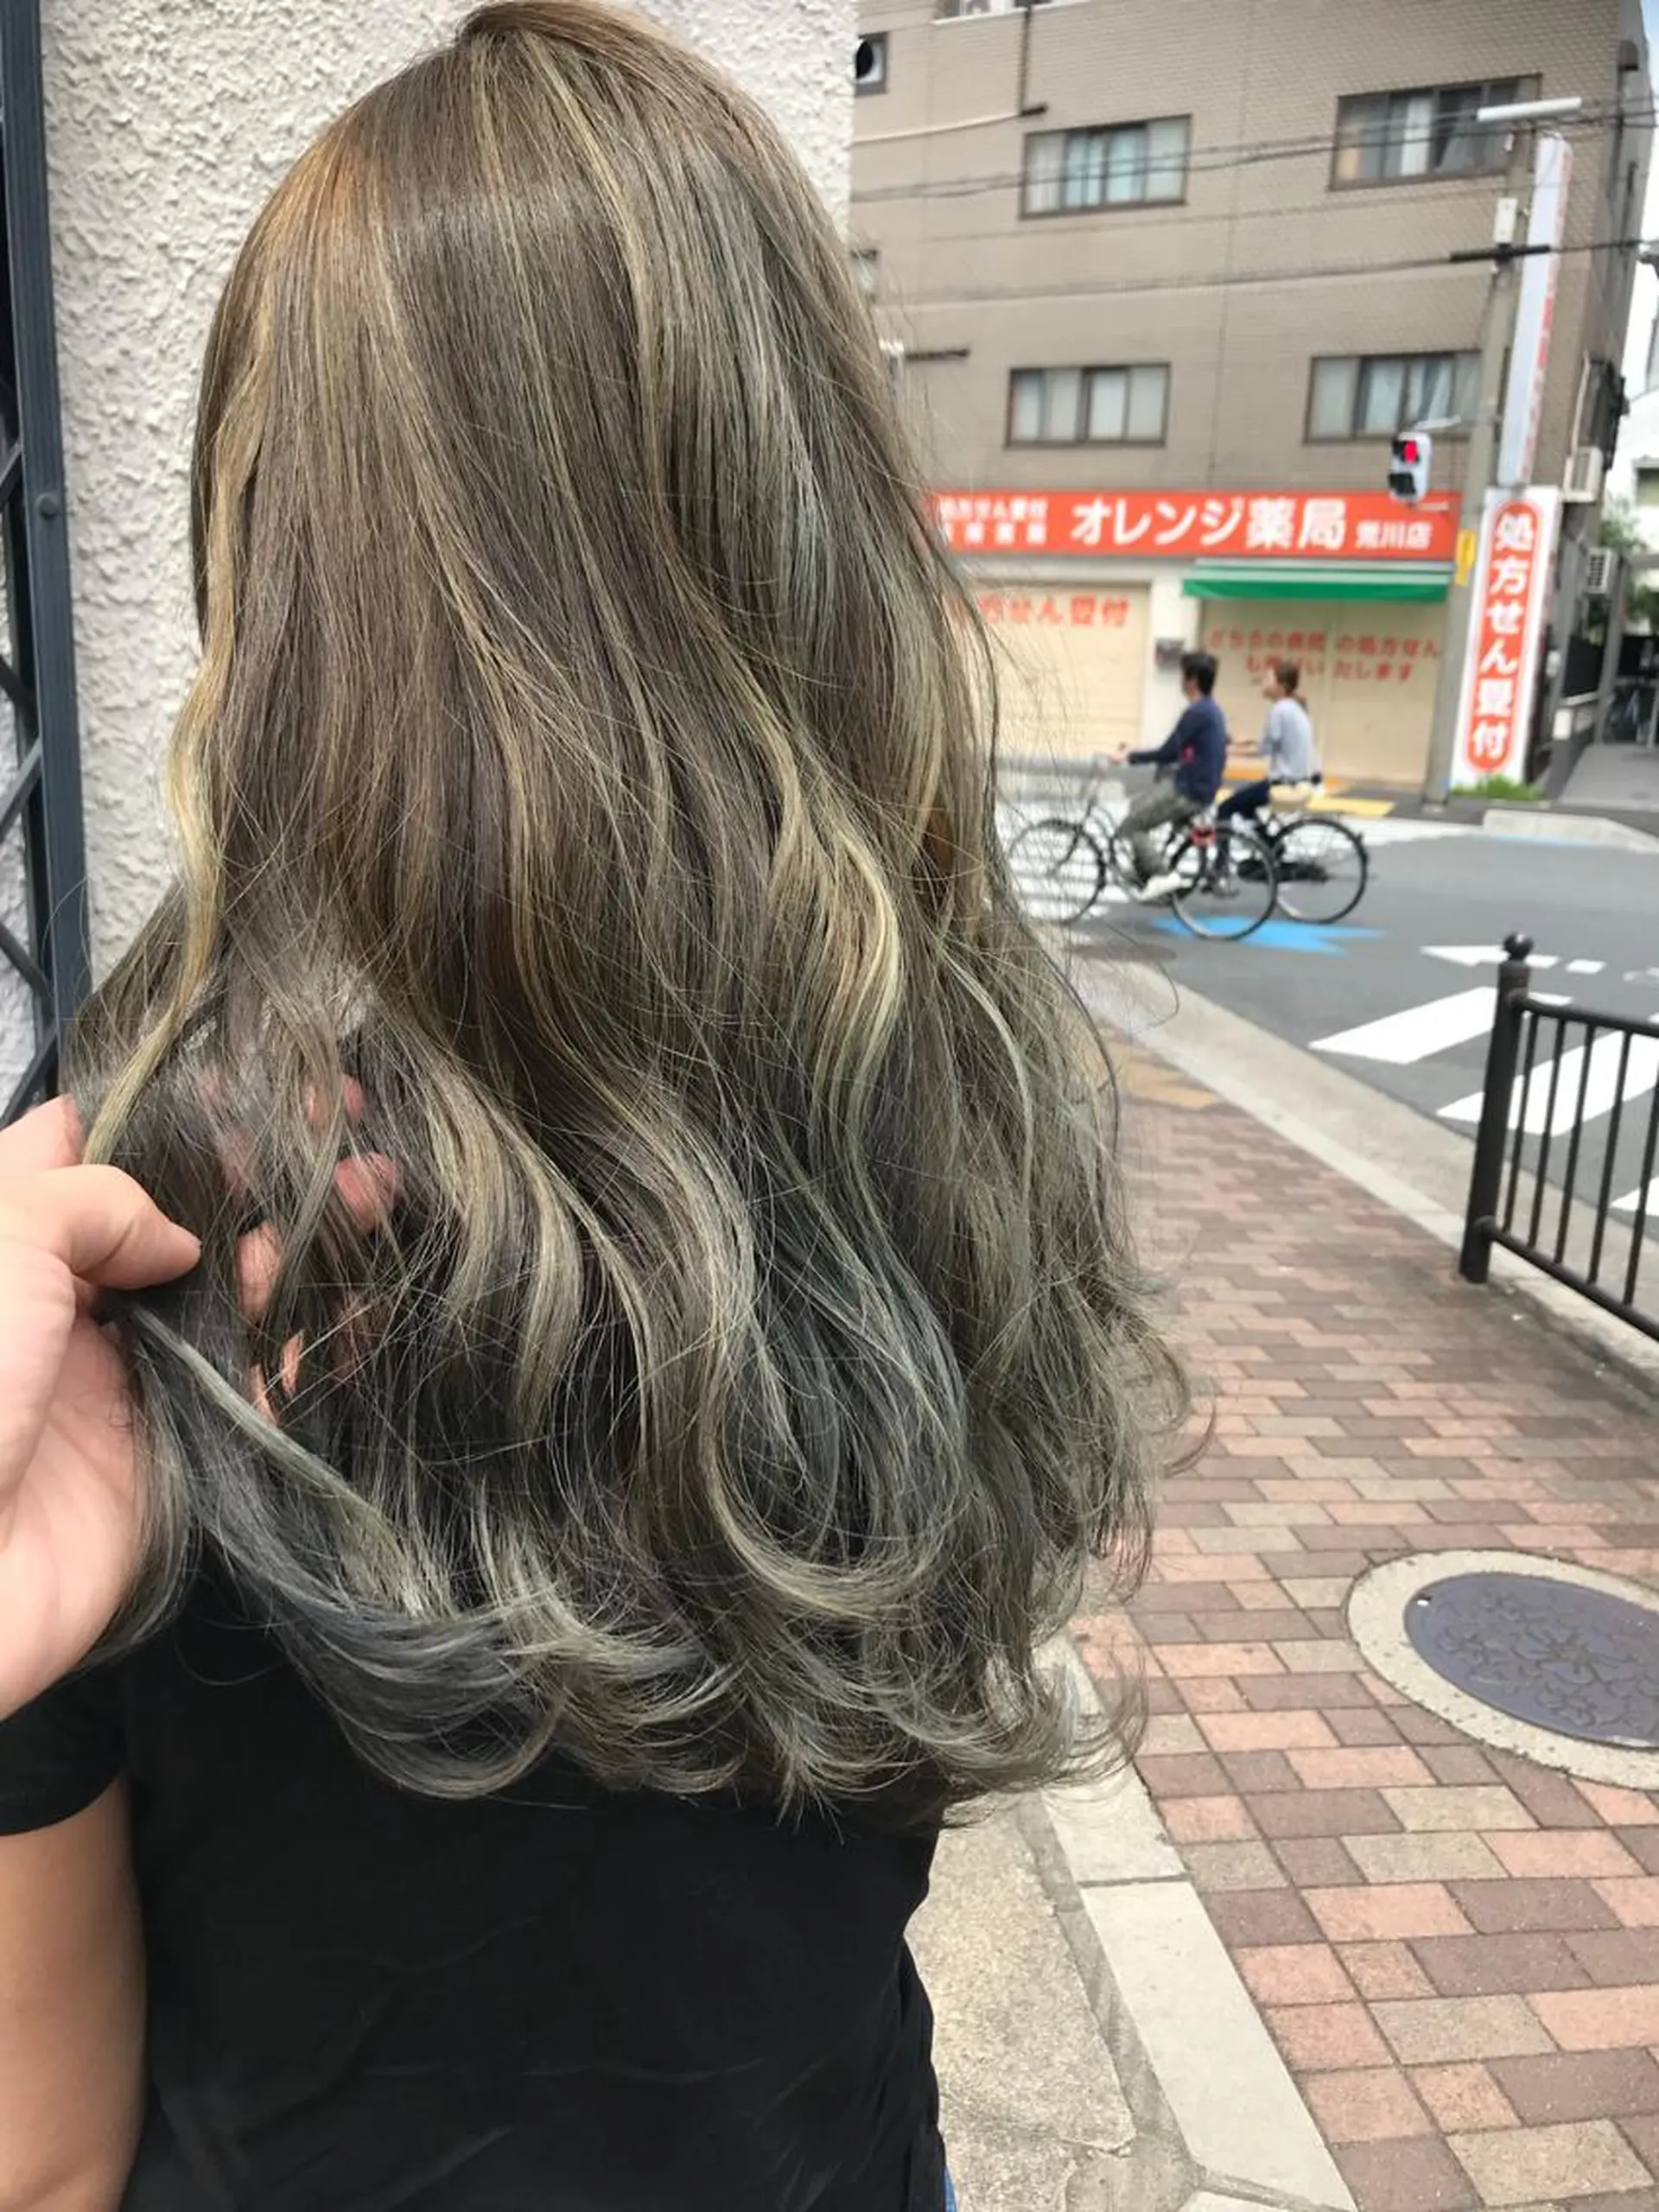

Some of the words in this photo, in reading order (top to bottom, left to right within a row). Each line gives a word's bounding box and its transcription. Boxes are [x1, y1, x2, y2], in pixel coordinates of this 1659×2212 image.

[1071, 496, 1346, 550] オレンジ薬局
[1473, 513, 1534, 759] 処方せん受付
